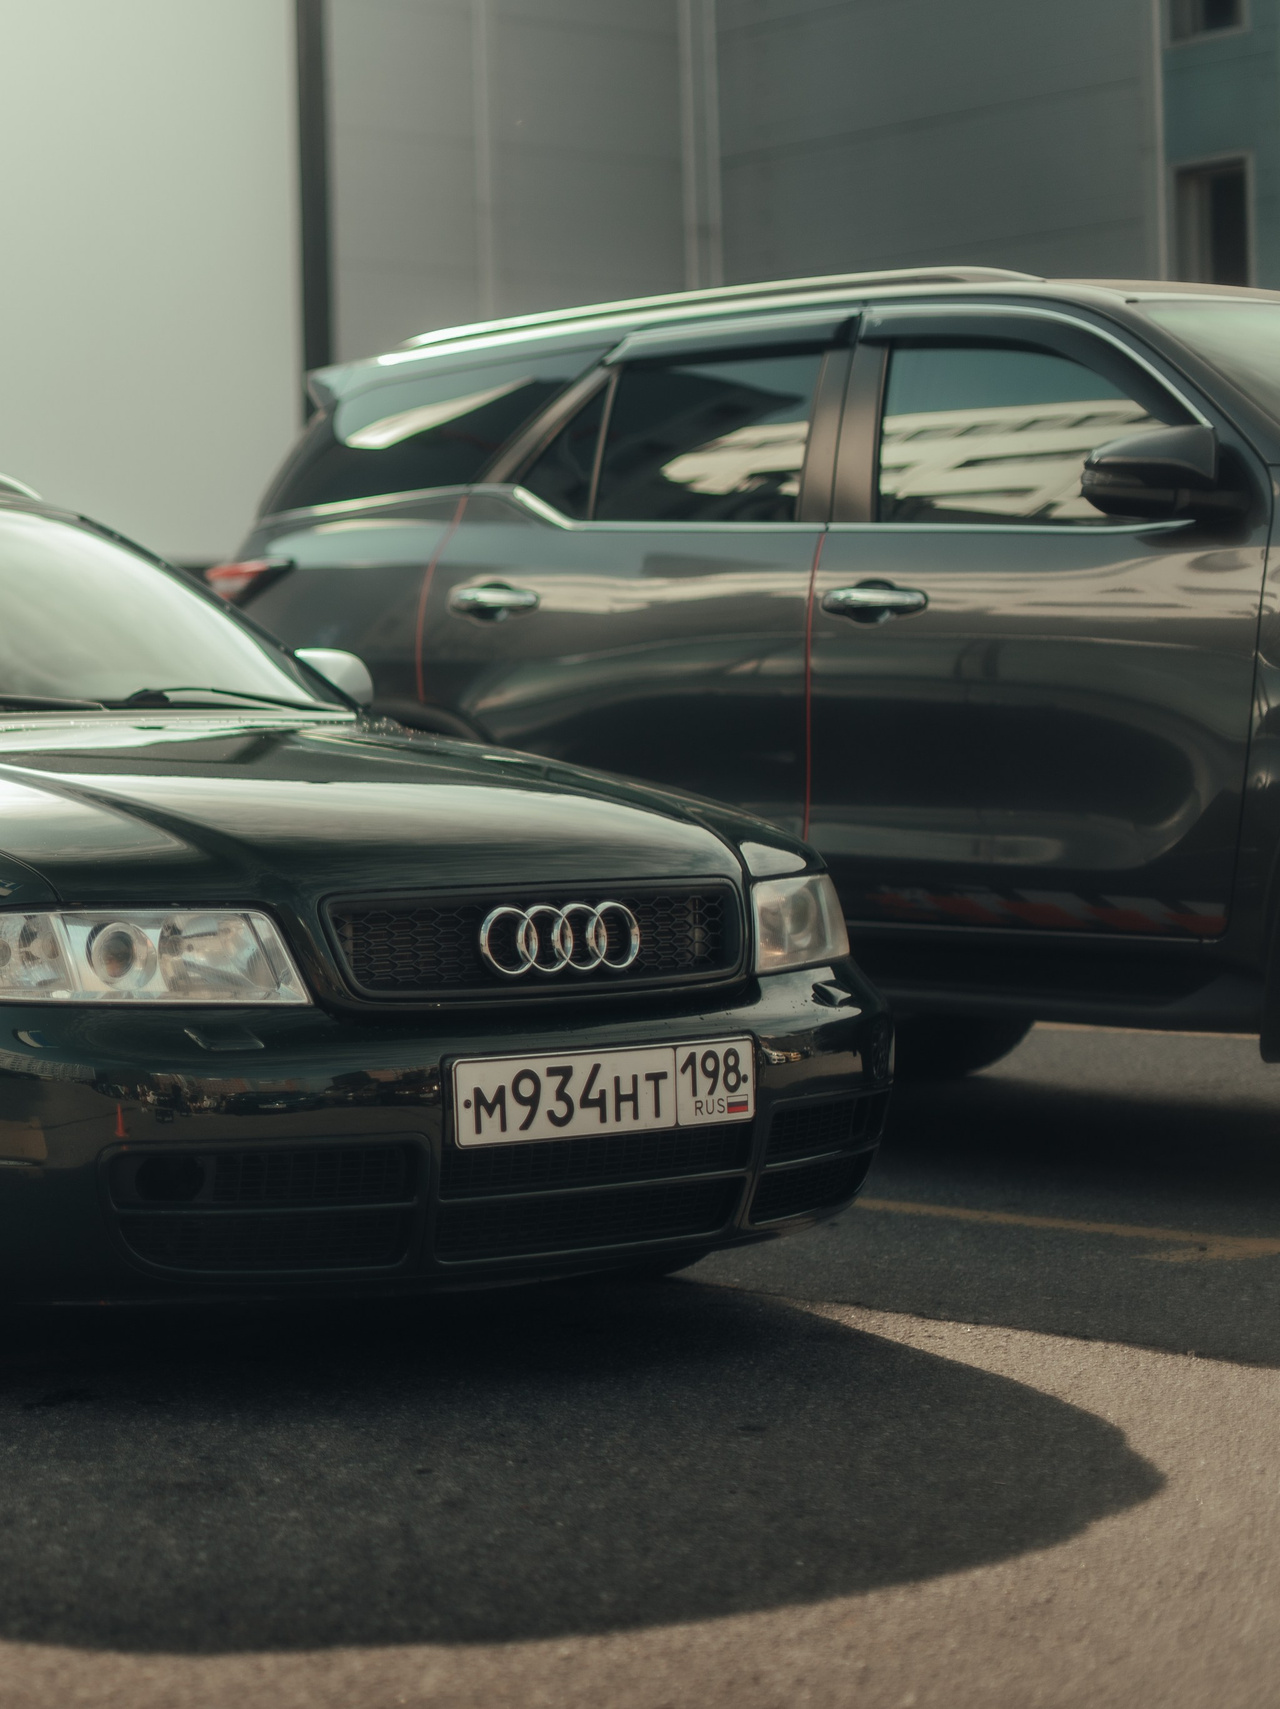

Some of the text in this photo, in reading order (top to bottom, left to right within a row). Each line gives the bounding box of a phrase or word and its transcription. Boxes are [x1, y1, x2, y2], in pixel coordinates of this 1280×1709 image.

[473, 1048, 741, 1134] М934НТ 198
[694, 1098, 726, 1117] RUS
